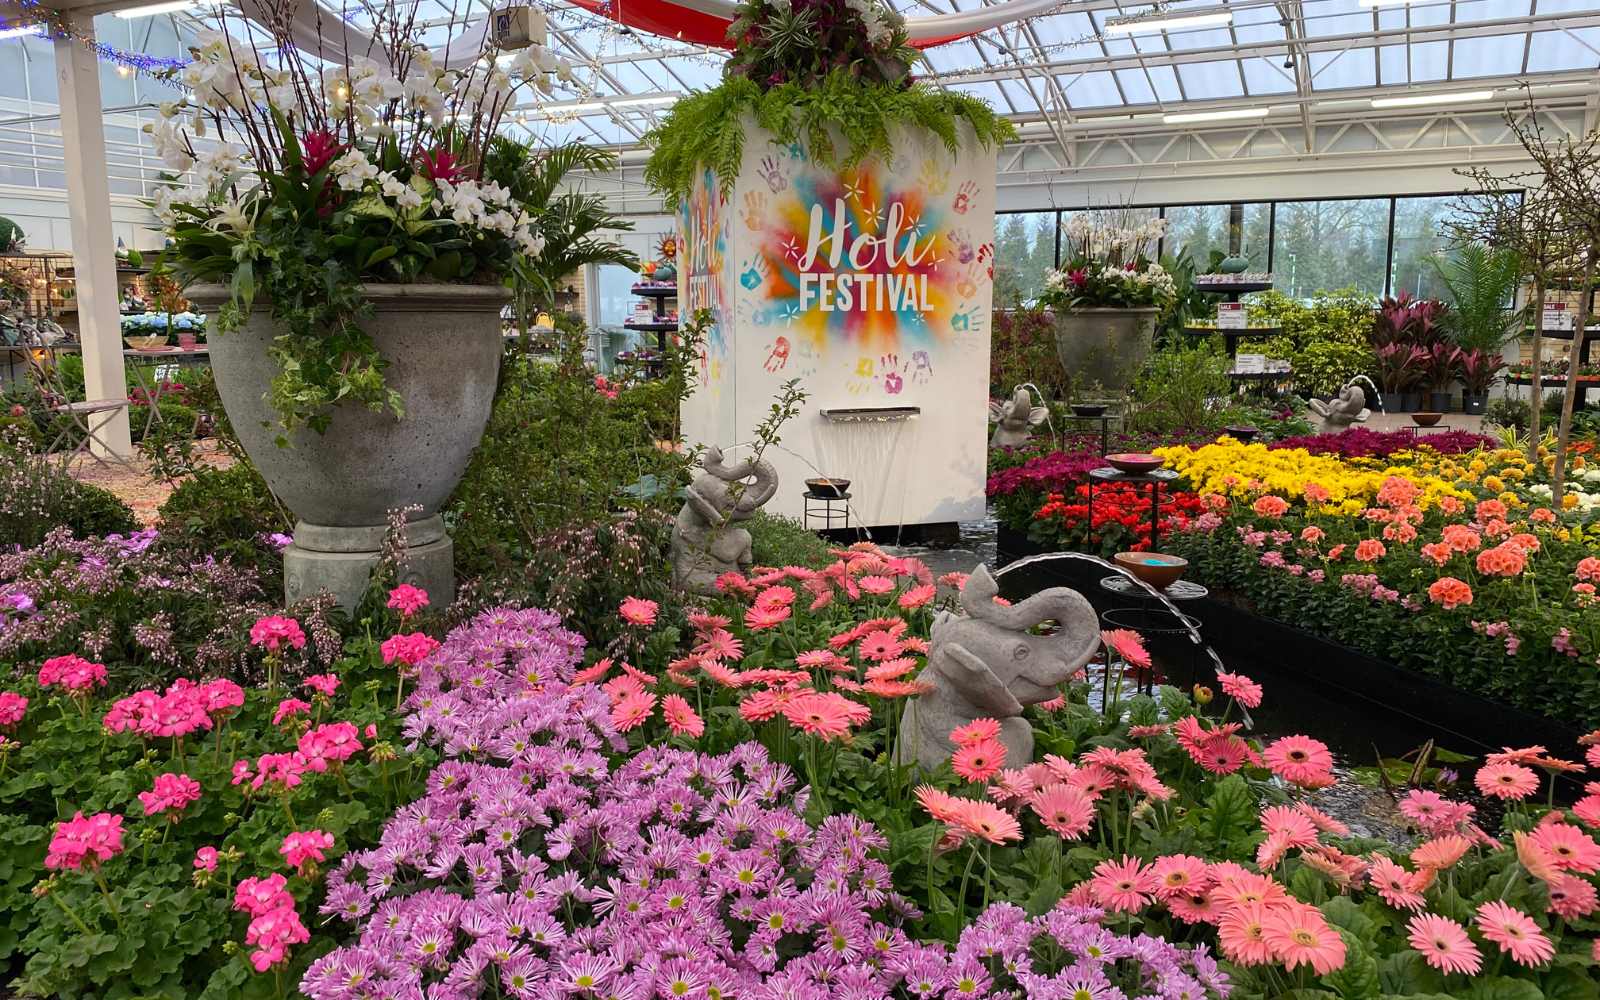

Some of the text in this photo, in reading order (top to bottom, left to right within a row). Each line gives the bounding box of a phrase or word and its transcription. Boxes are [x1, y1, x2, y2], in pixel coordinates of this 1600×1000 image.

[690, 204, 719, 275] Holi
[798, 198, 936, 272] Holi
[689, 273, 720, 311] FESTIVAL
[799, 272, 935, 312] FESTIVAL
